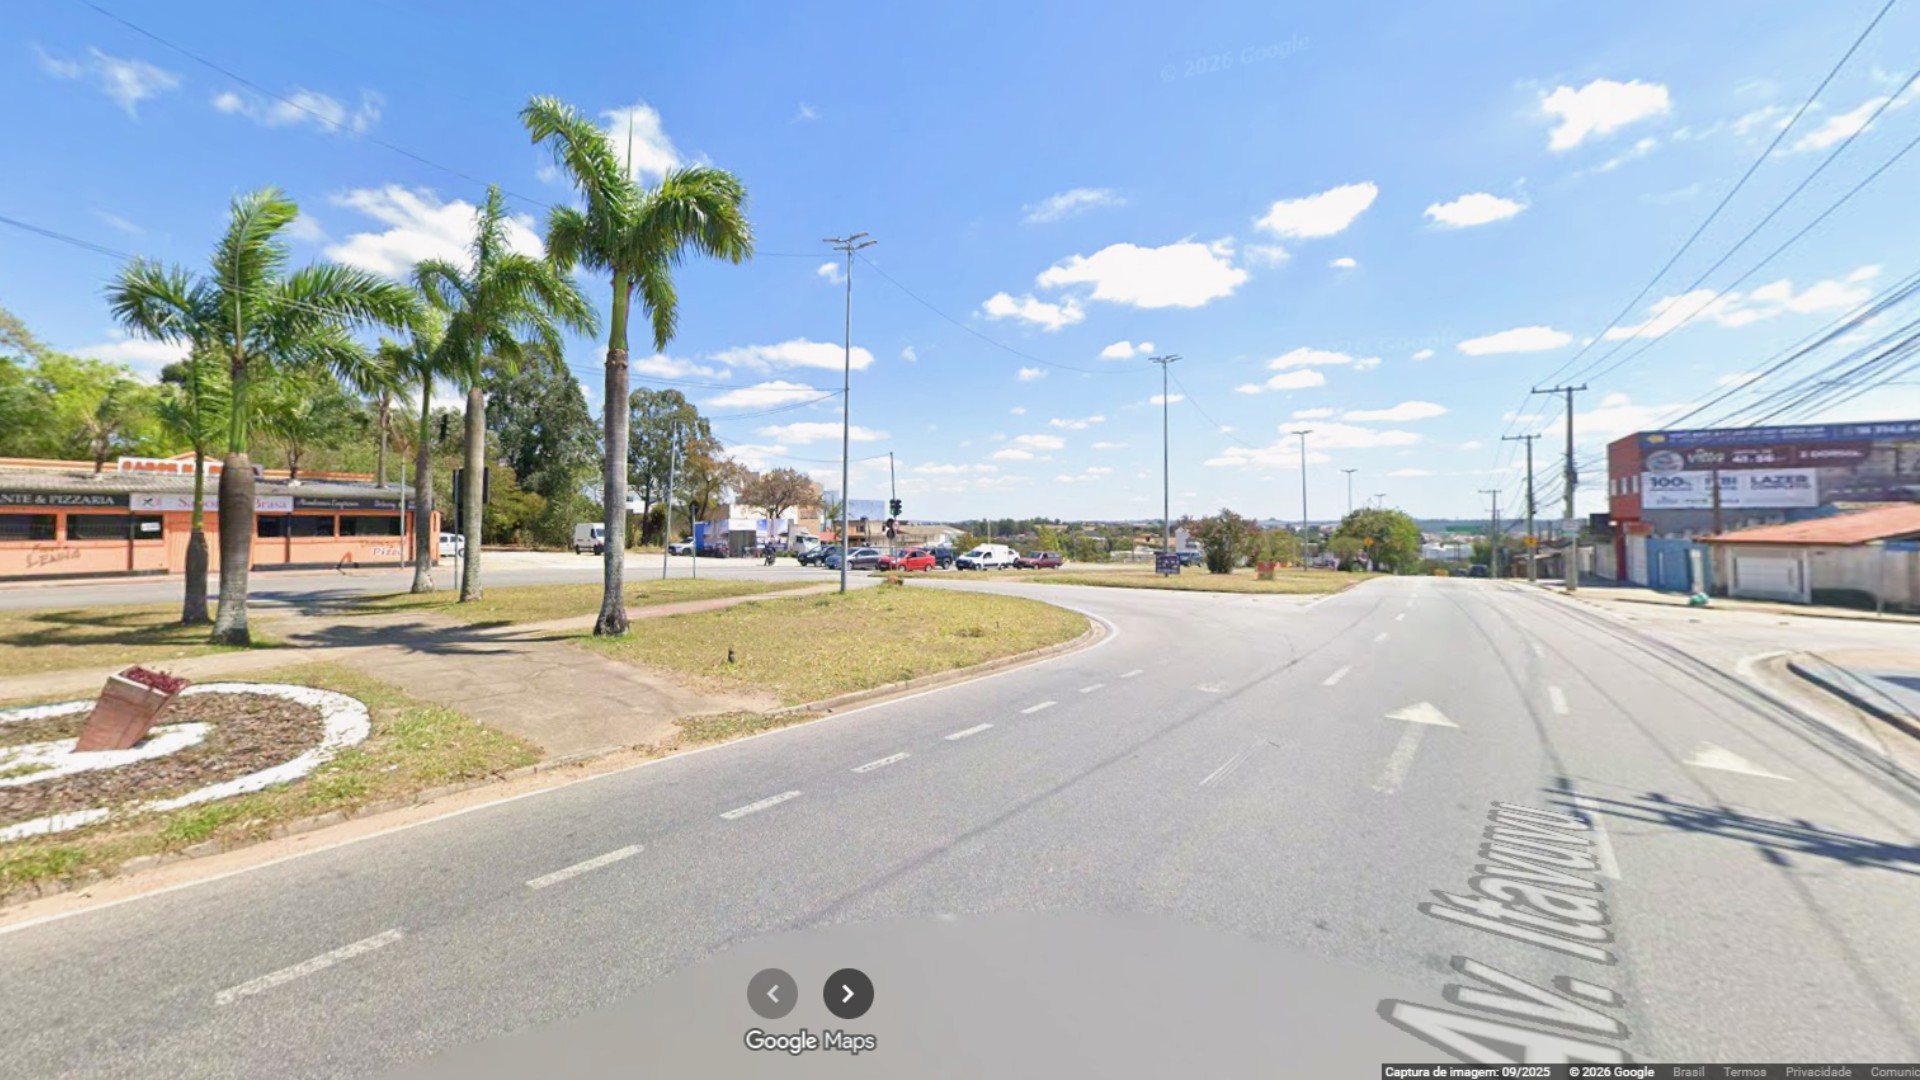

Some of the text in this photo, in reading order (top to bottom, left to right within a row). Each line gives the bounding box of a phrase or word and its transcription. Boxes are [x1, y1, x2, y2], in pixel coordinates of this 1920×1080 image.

[1750, 475, 1809, 483] LAZER
[0, 494, 115, 505] NTE & PIZZARIA
[177, 496, 219, 508] Saor
